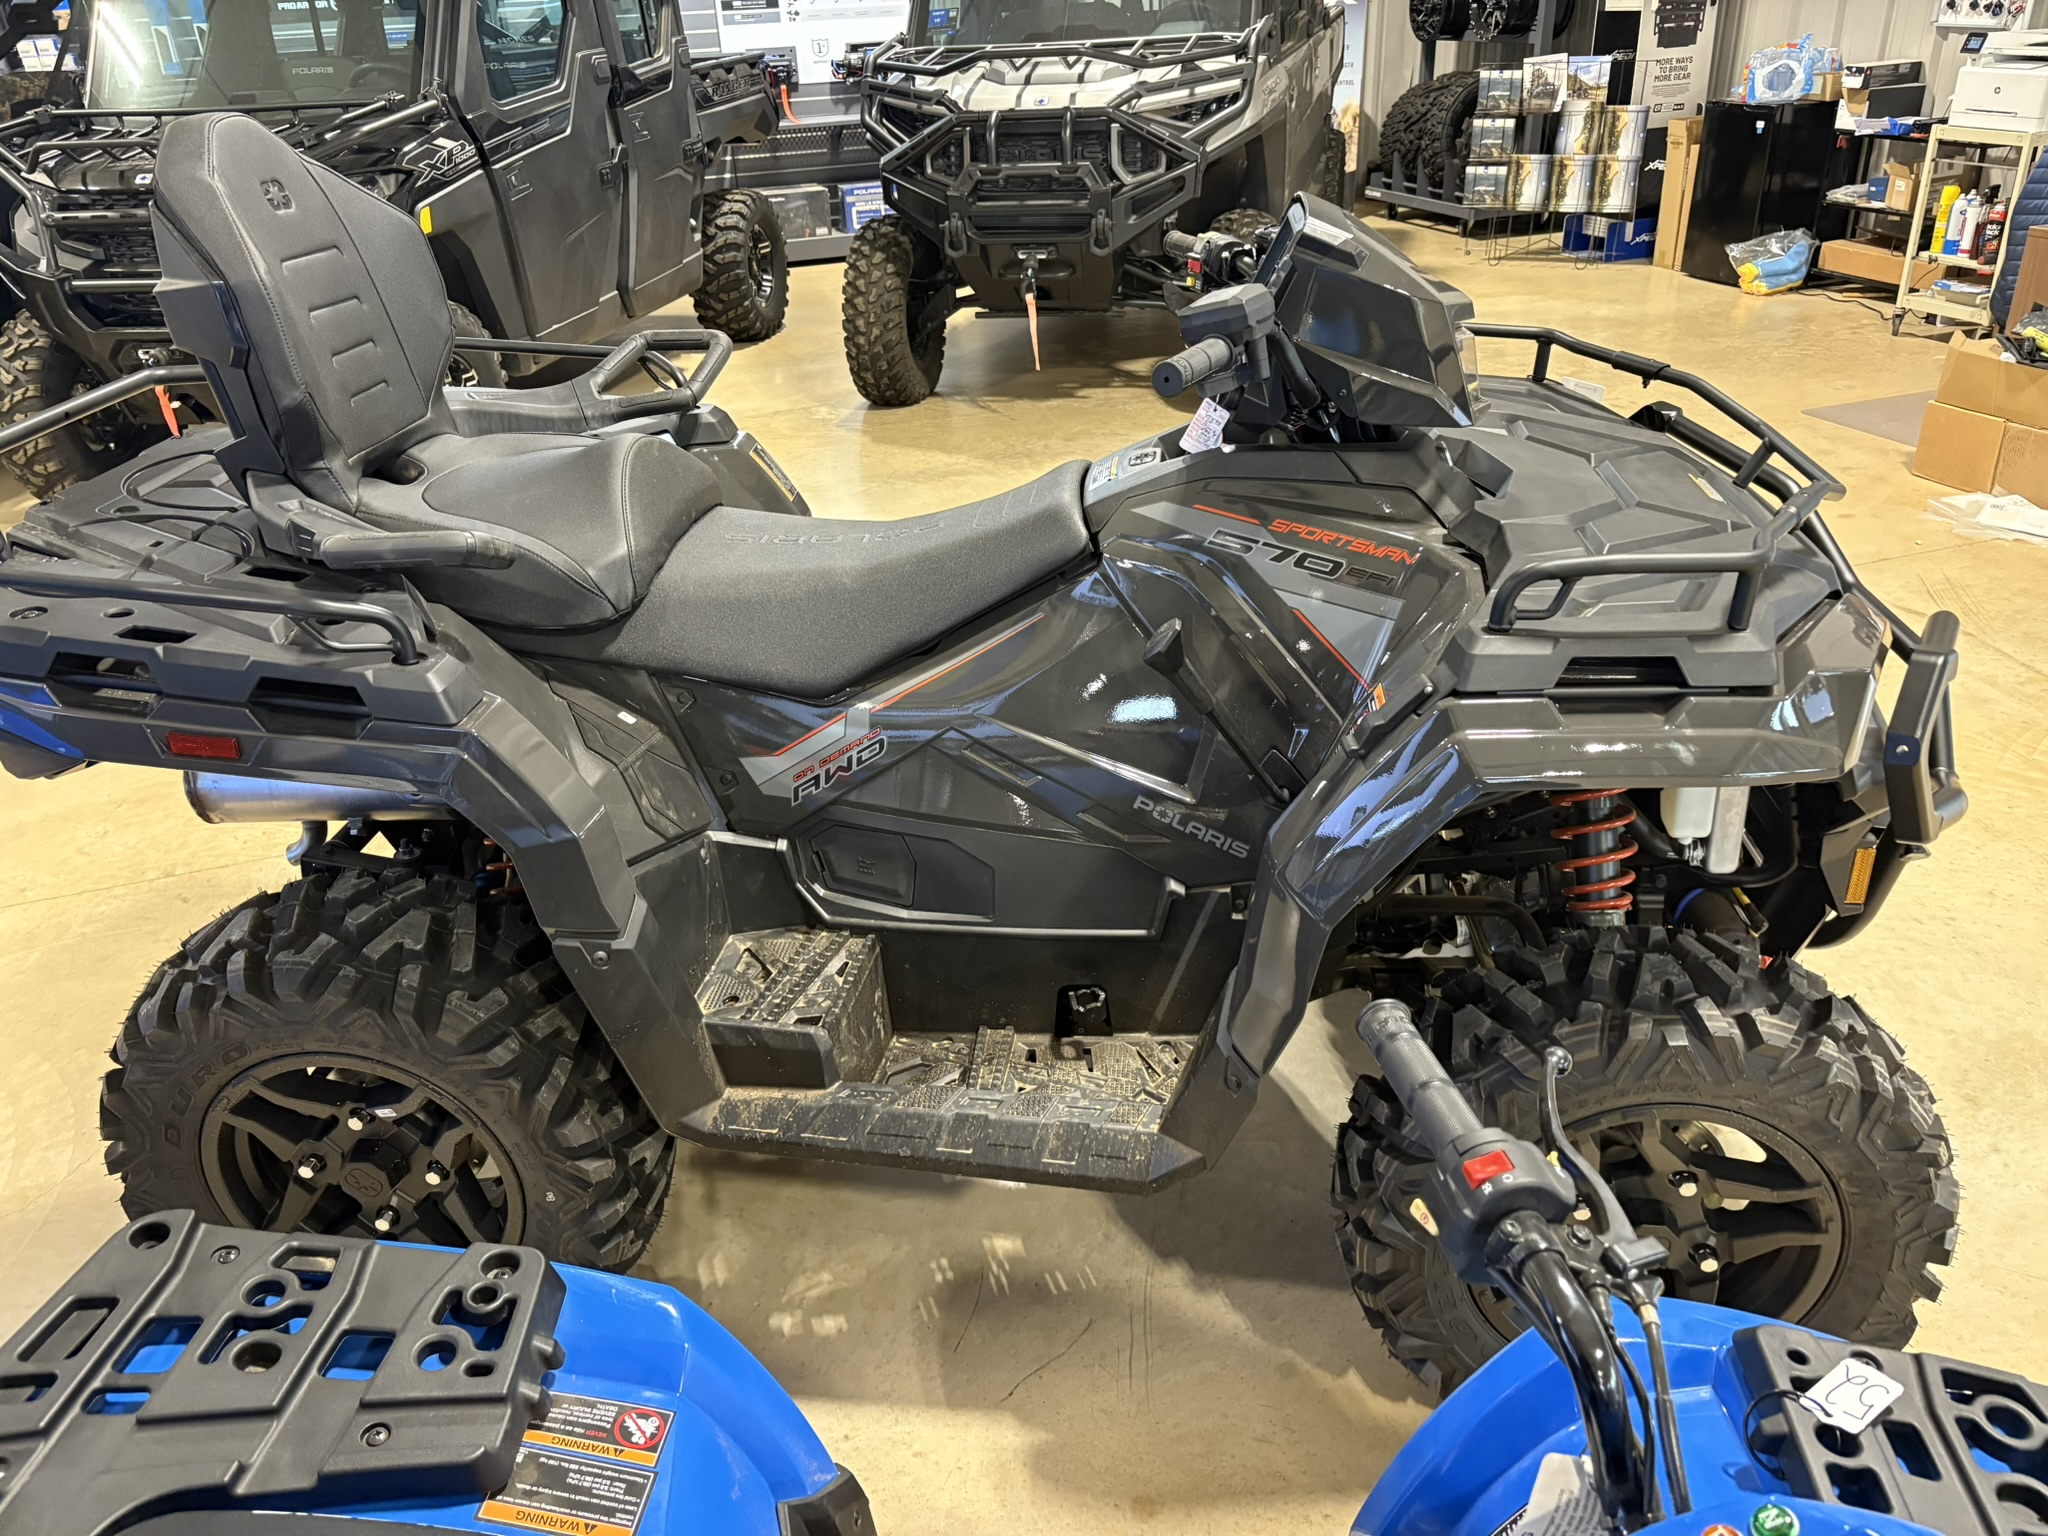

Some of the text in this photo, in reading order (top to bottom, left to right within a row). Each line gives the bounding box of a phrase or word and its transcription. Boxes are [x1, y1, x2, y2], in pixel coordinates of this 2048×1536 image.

[277, 0, 328, 10] PROAROR
[1656, 56, 1694, 66] MORE WAYS
[1659, 65, 1688, 74] TO BRING
[292, 66, 334, 74] POLARIS
[1654, 73, 1691, 83] MORE GEAR
[455, 149, 476, 164] 1000
[1268, 519, 1416, 565] SPORTSMAN
[1204, 528, 1397, 588] 570 EFI
[791, 736, 887, 807] AWD
[1132, 795, 1252, 859] POLARIS
[163, 1043, 252, 1151] DURO
[585, 1429, 607, 1437] NEVER
[551, 1436, 610, 1455] WARNING
[515, 1510, 581, 1532] WARNING
